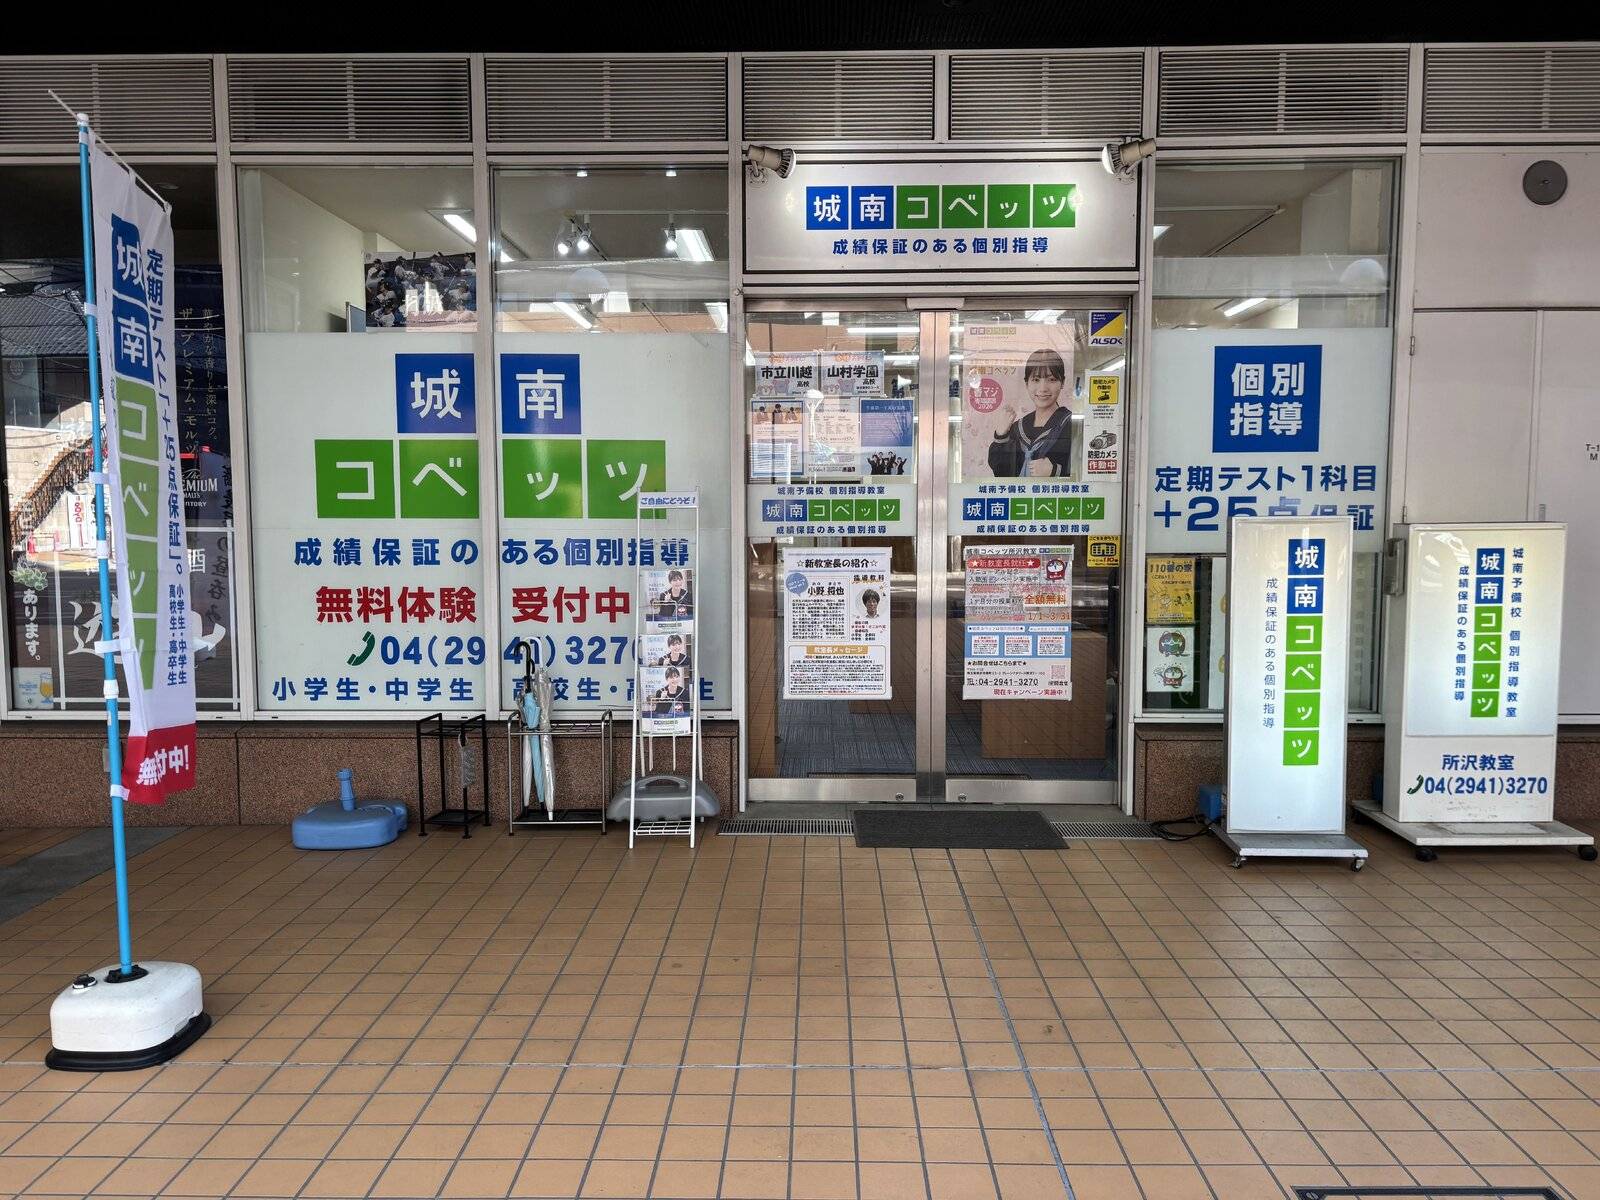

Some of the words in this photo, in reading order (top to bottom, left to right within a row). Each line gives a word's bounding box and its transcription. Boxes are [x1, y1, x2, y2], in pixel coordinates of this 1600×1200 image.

[813, 193, 1068, 223] 城南コベッツ
[832, 237, 1049, 255] 成績保証のある個別指導
[1091, 337, 1122, 345] ALSOK
[761, 365, 813, 380] 市立川越
[827, 364, 879, 378] 山村学園
[1231, 362, 1305, 397] 個別
[410, 368, 566, 420] 城南
[1230, 402, 1303, 436] 指導
[1088, 450, 1117, 459] 防犯カメラ
[1089, 460, 1116, 469] 作動中
[336, 457, 648, 501] コベッツ
[778, 486, 824, 495] 城南予備校
[829, 486, 885, 494] 個別指導教室
[979, 484, 1026, 494] 城南予備校
[1032, 484, 1090, 493] 個別指導教室
[1154, 465, 1376, 492] 定期テスト1科目
[767, 503, 896, 518] 城南コベッツ
[967, 502, 1100, 517] 城南コベッツ
[776, 525, 886, 535] 成績保証のある個別指導
[976, 524, 1090, 533] 成績保証のある個別指導
[294, 537, 690, 567] 成績保証のある個別指導
[805, 558, 869, 568] 新教室長の紹介
[1510, 547, 1524, 618] 城南予備校
[316, 586, 478, 624] 無料体験
[511, 586, 631, 624] 受付中
[176, 583, 188, 685] 小学生・中学生
[1454, 565, 1470, 702] 成績保証のある個別指導
[1476, 552, 1501, 713] 城南コベッツ
[1263, 577, 1279, 729] 成績保証のある個別指導
[1291, 545, 1320, 759] 城南コベッツ
[1506, 630, 1521, 718] 個別指導教室
[272, 677, 475, 702] 小学生・中学生
[1442, 754, 1515, 772] 所沢教室
[1424, 776, 1548, 797] 04(2941)3270
